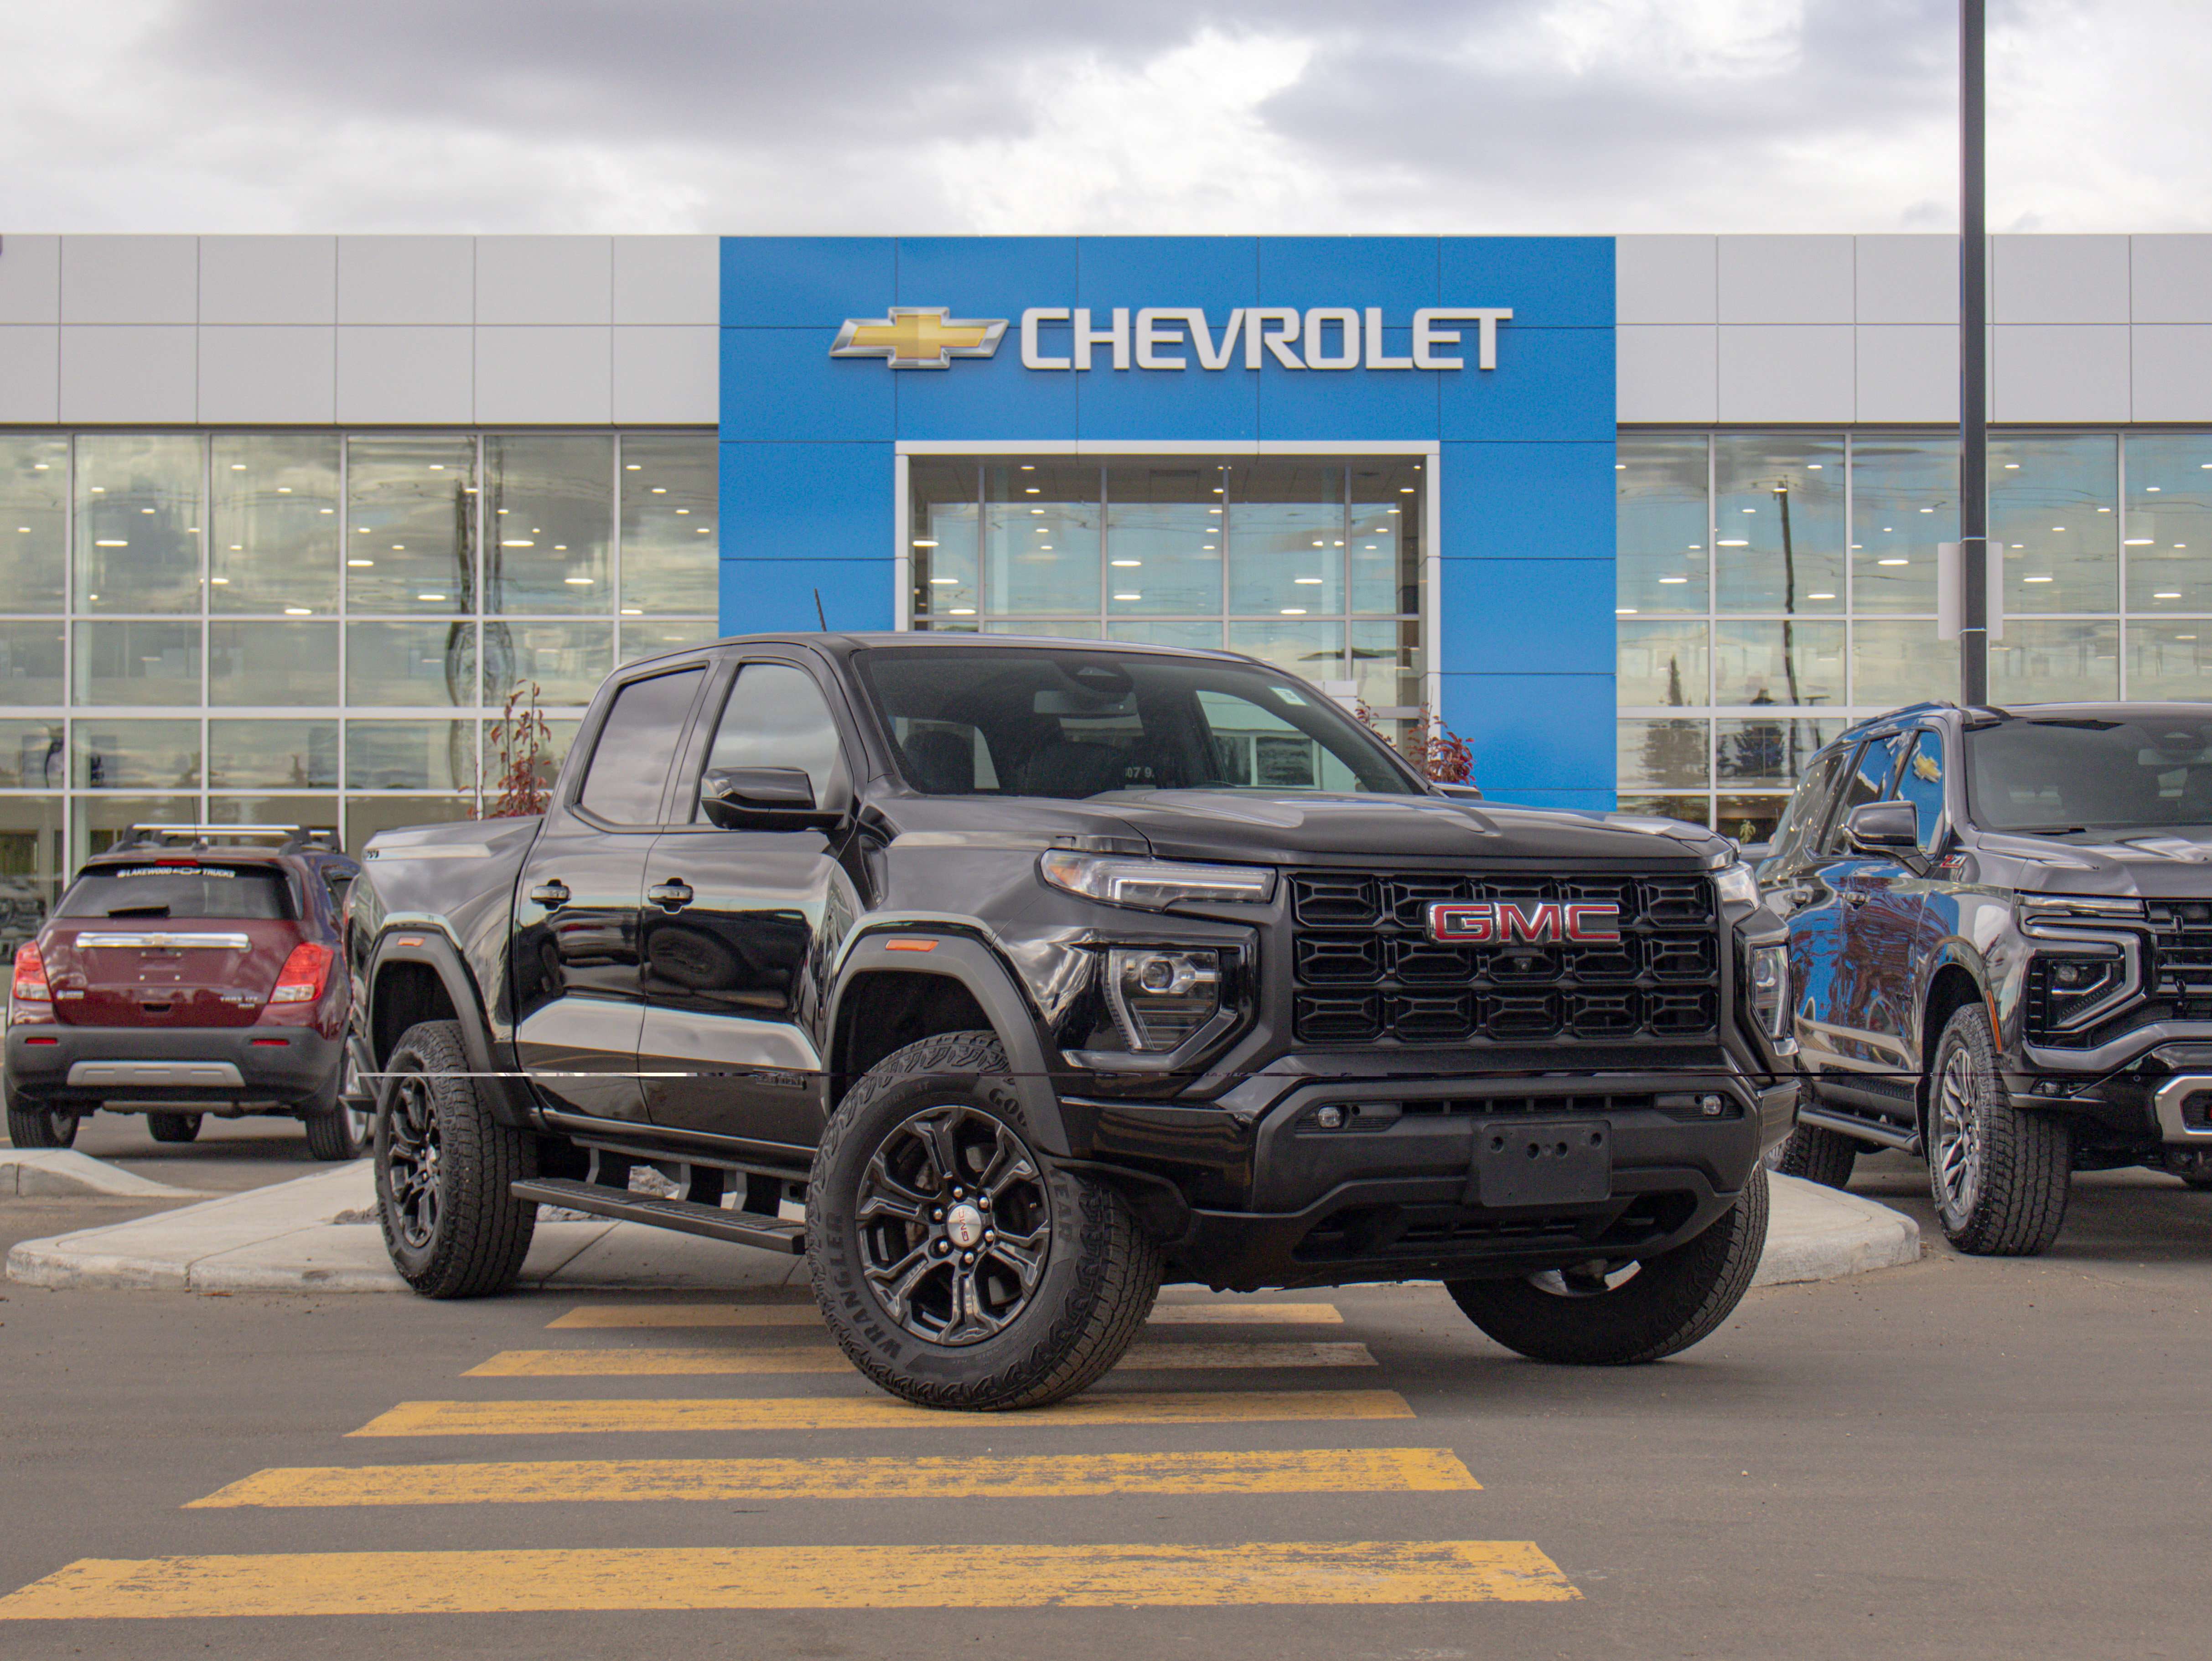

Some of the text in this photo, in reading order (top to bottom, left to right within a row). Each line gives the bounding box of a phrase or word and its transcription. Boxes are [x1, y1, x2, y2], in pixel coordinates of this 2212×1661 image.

[1021, 307, 1513, 369] CHEVROLET
[126, 867, 236, 878] LAKEWOOD TRUCKS
[1430, 902, 1620, 943] GMC
[958, 1209, 969, 1241] GMC
[826, 1211, 902, 1360] WRANGLER
